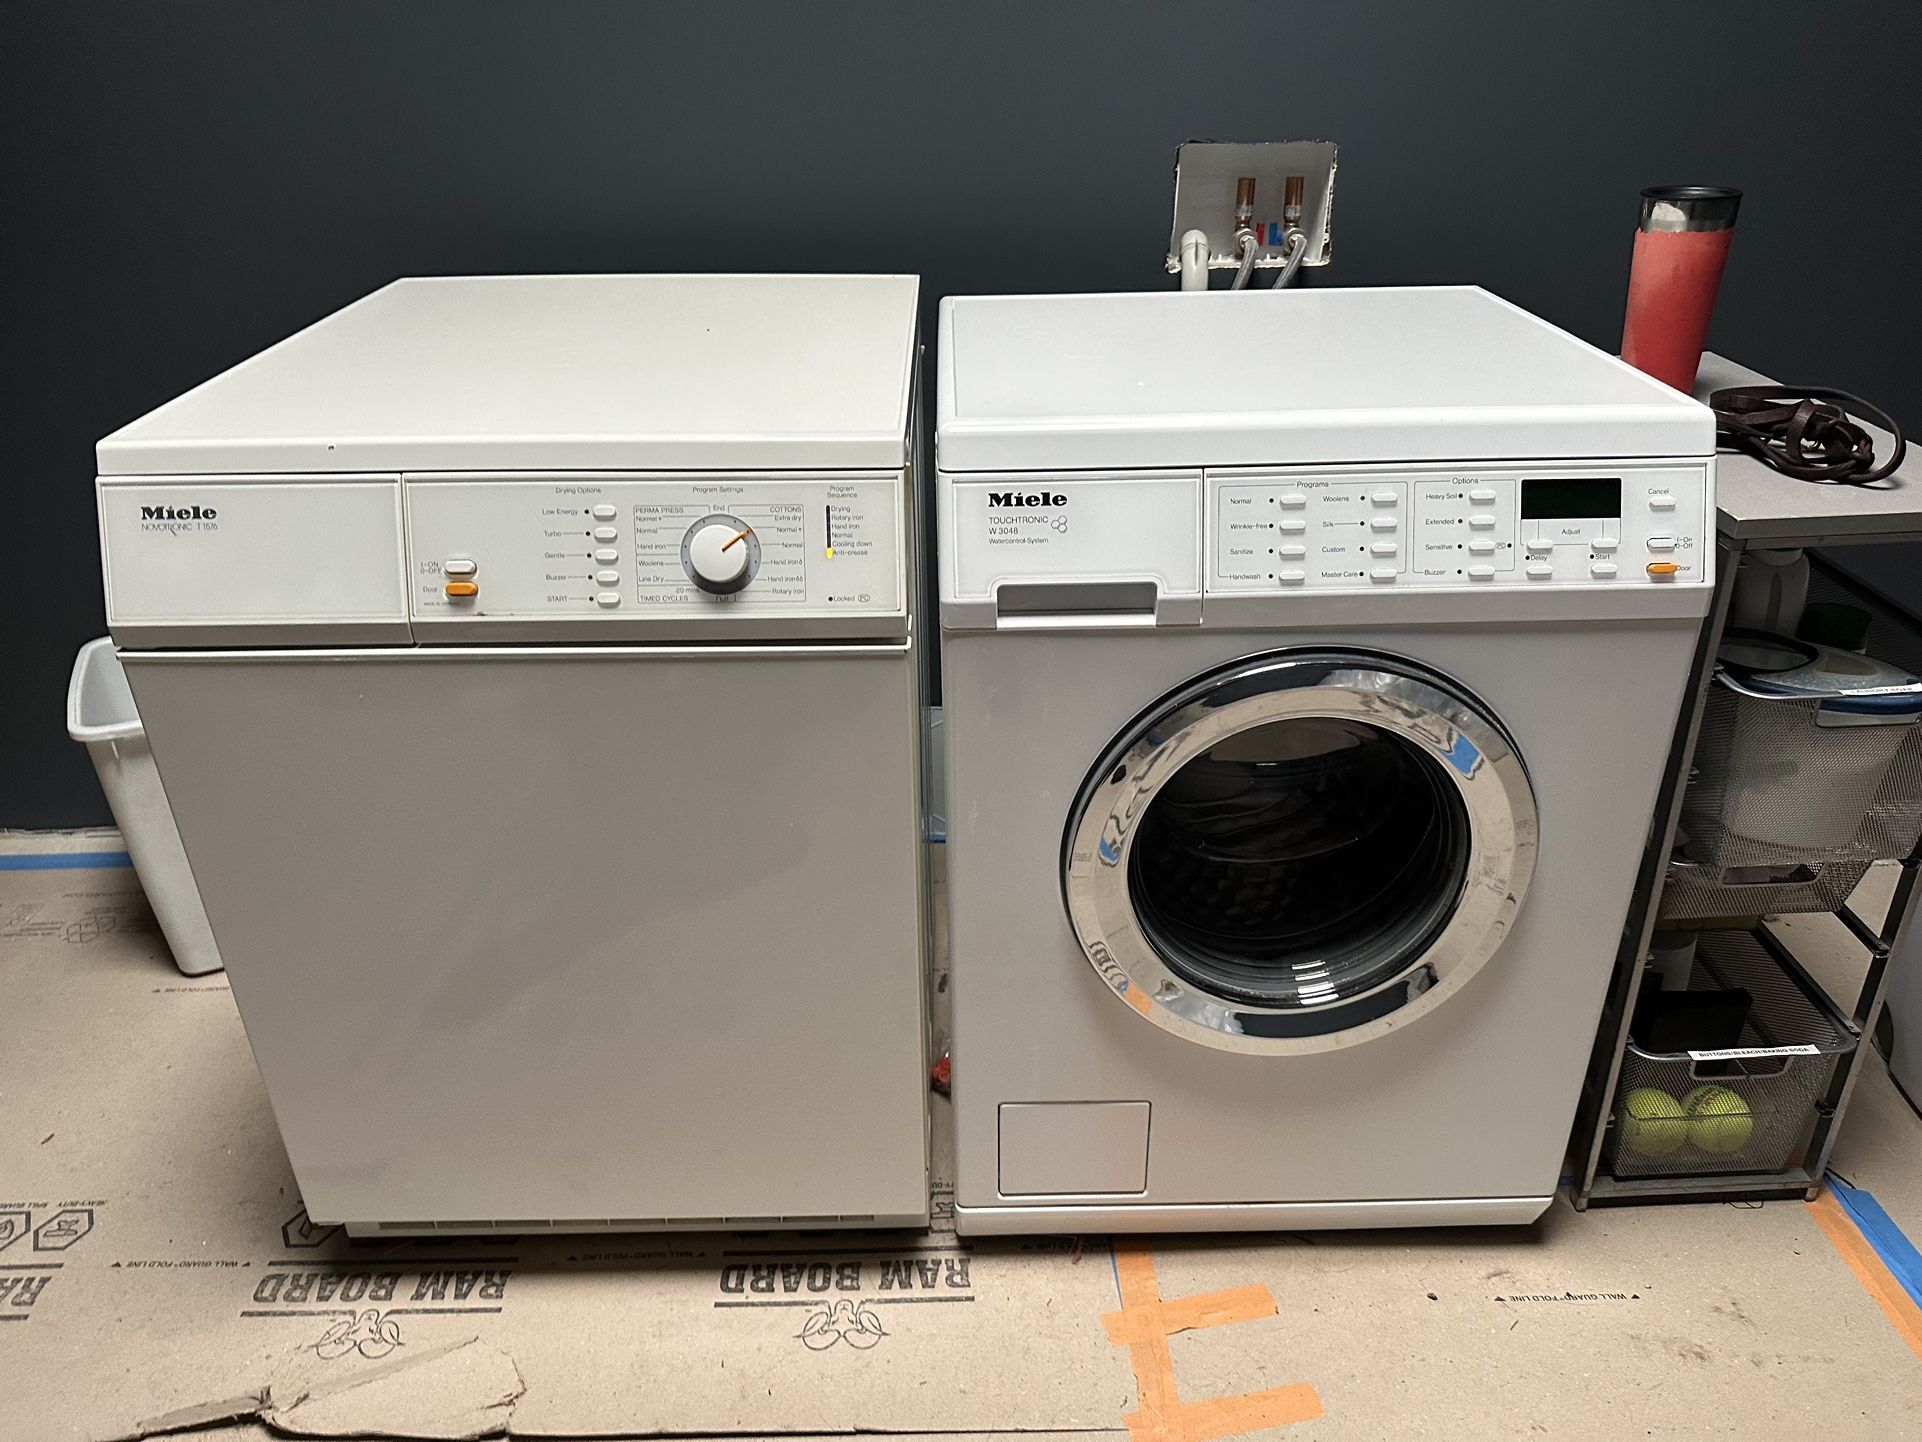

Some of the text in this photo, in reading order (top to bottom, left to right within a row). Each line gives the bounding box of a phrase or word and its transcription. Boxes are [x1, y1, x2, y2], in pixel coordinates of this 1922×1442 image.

[1296, 481, 1329, 489] Programs
[1451, 477, 1479, 485] Options
[555, 487, 601, 495] Drying Options
[692, 486, 744, 494] Program Settings
[1647, 487, 1670, 495] Cancel
[988, 492, 1068, 507] Miele
[141, 505, 217, 520] Miele
[556, 508, 578, 516] Energy
[831, 505, 851, 513] Drying
[988, 515, 1049, 524] TOUCHTRONIC
[141, 522, 193, 536] NOVOTRONIC
[988, 527, 1019, 535] W 3048
[1561, 528, 1581, 536] Adjust
[1425, 543, 1453, 551] Sensitive
[1530, 554, 1548, 562] Delay
[652, 576, 664, 584] Dry
[719, 1258, 971, 1294] RAM BOARD
[252, 1270, 512, 1303] RAM BOARD
